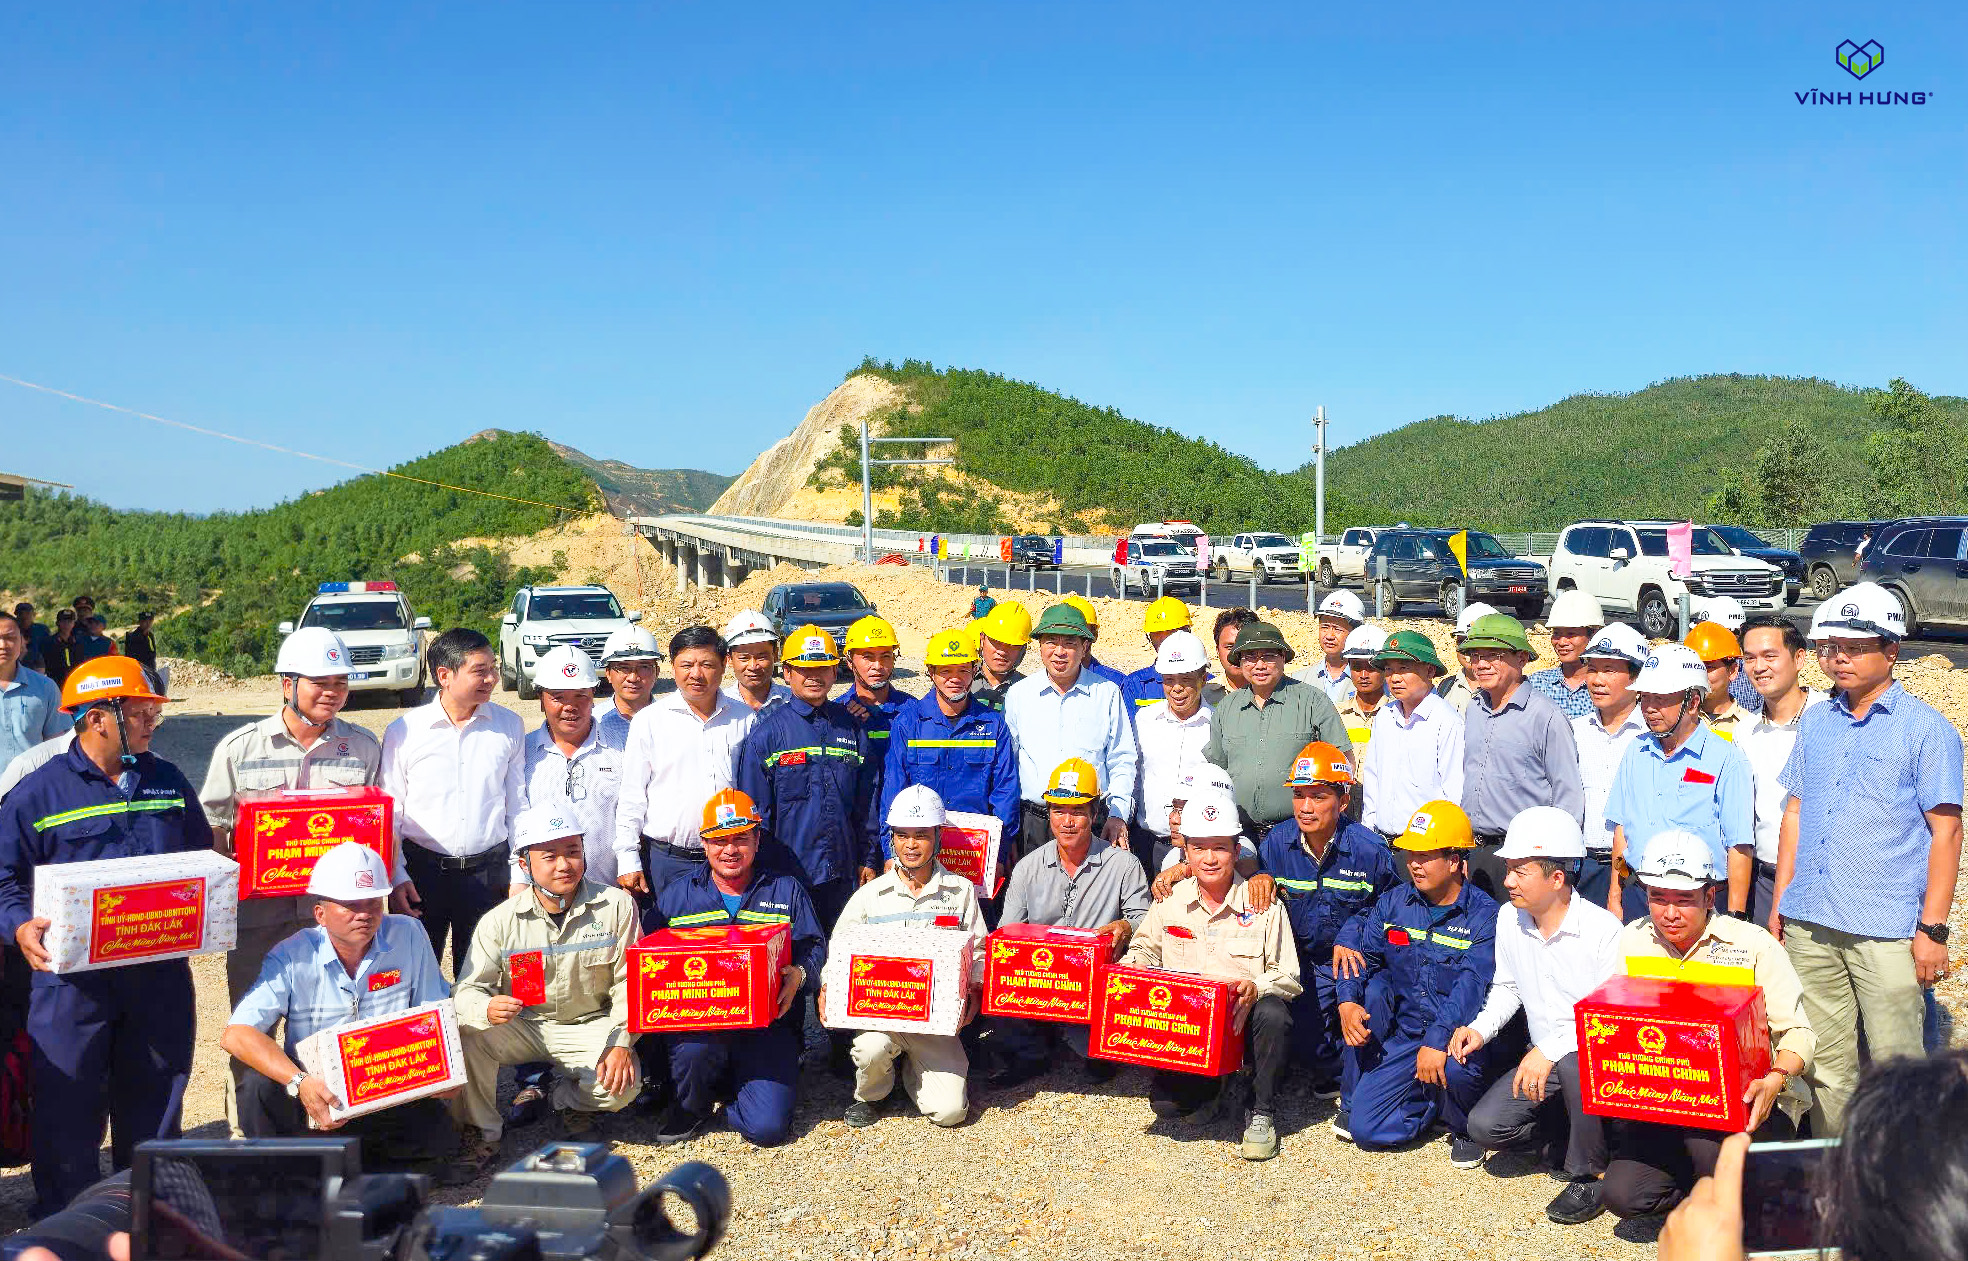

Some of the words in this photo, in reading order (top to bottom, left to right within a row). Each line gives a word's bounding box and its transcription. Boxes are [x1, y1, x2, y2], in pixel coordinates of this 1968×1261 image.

[268, 847, 301, 861] PHẠM
[1000, 975, 1027, 988] PHẠM
[1028, 977, 1053, 989] MINH
[1054, 980, 1082, 992] CHÍNH
[651, 989, 680, 1002] PHẠM
[682, 988, 708, 999] MINH
[710, 986, 740, 998] CHÍNH
[1113, 1013, 1142, 1028] PHẠM
[1143, 1017, 1169, 1031] MINH
[1171, 1021, 1201, 1036] CHÍNH
[1602, 1060, 1636, 1076] PHẠM
[1639, 1063, 1670, 1078] MINH
[1673, 1066, 1710, 1083] CHÍNH
